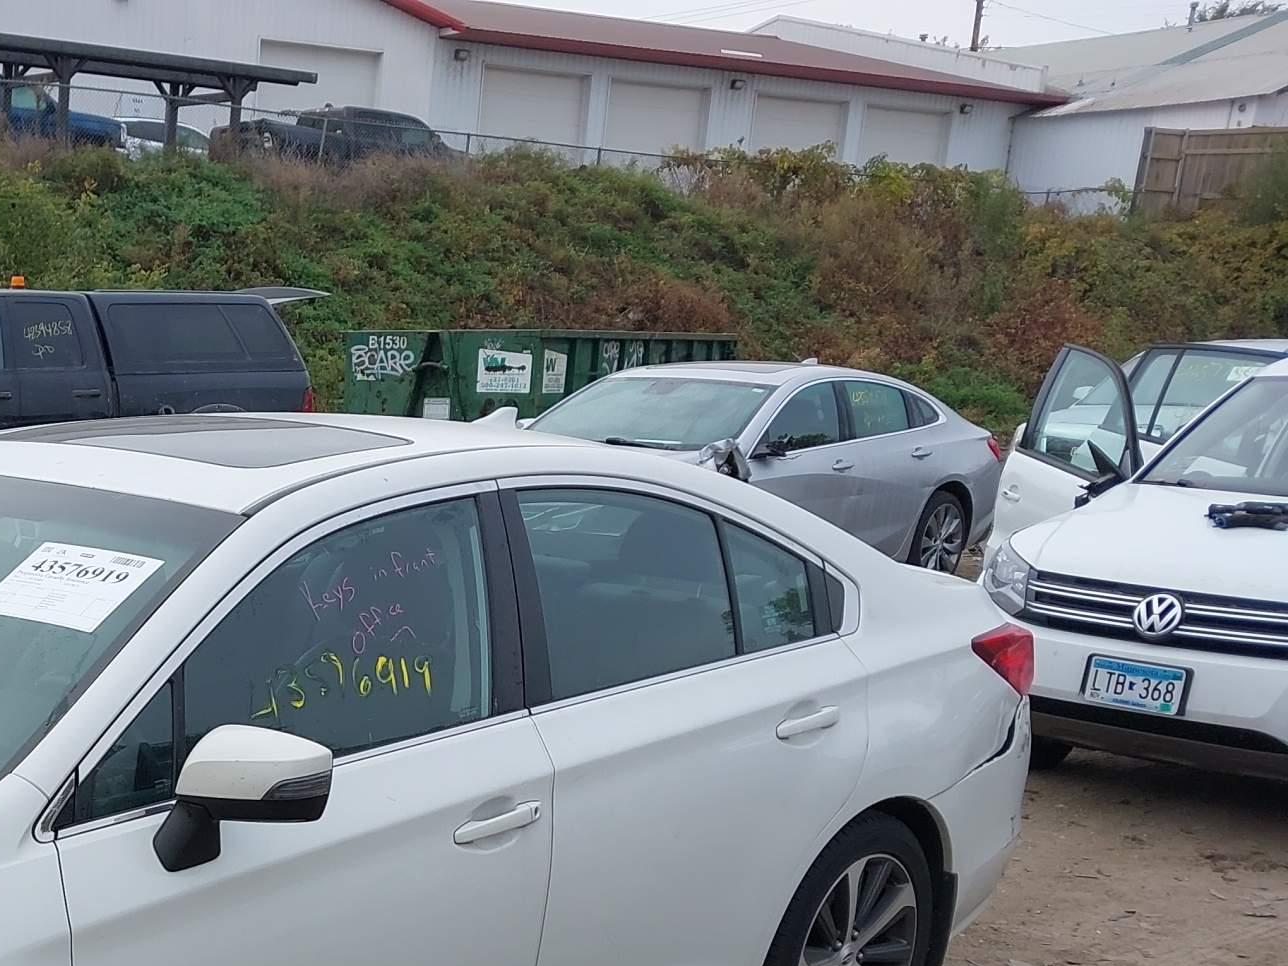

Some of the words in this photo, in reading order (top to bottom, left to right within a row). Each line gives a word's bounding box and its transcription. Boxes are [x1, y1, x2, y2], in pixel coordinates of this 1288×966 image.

[369, 336, 407, 349] B1530
[31, 558, 130, 584] 43576919
[1090, 669, 1127, 695] LTB
[1138, 678, 1175, 703] 368
